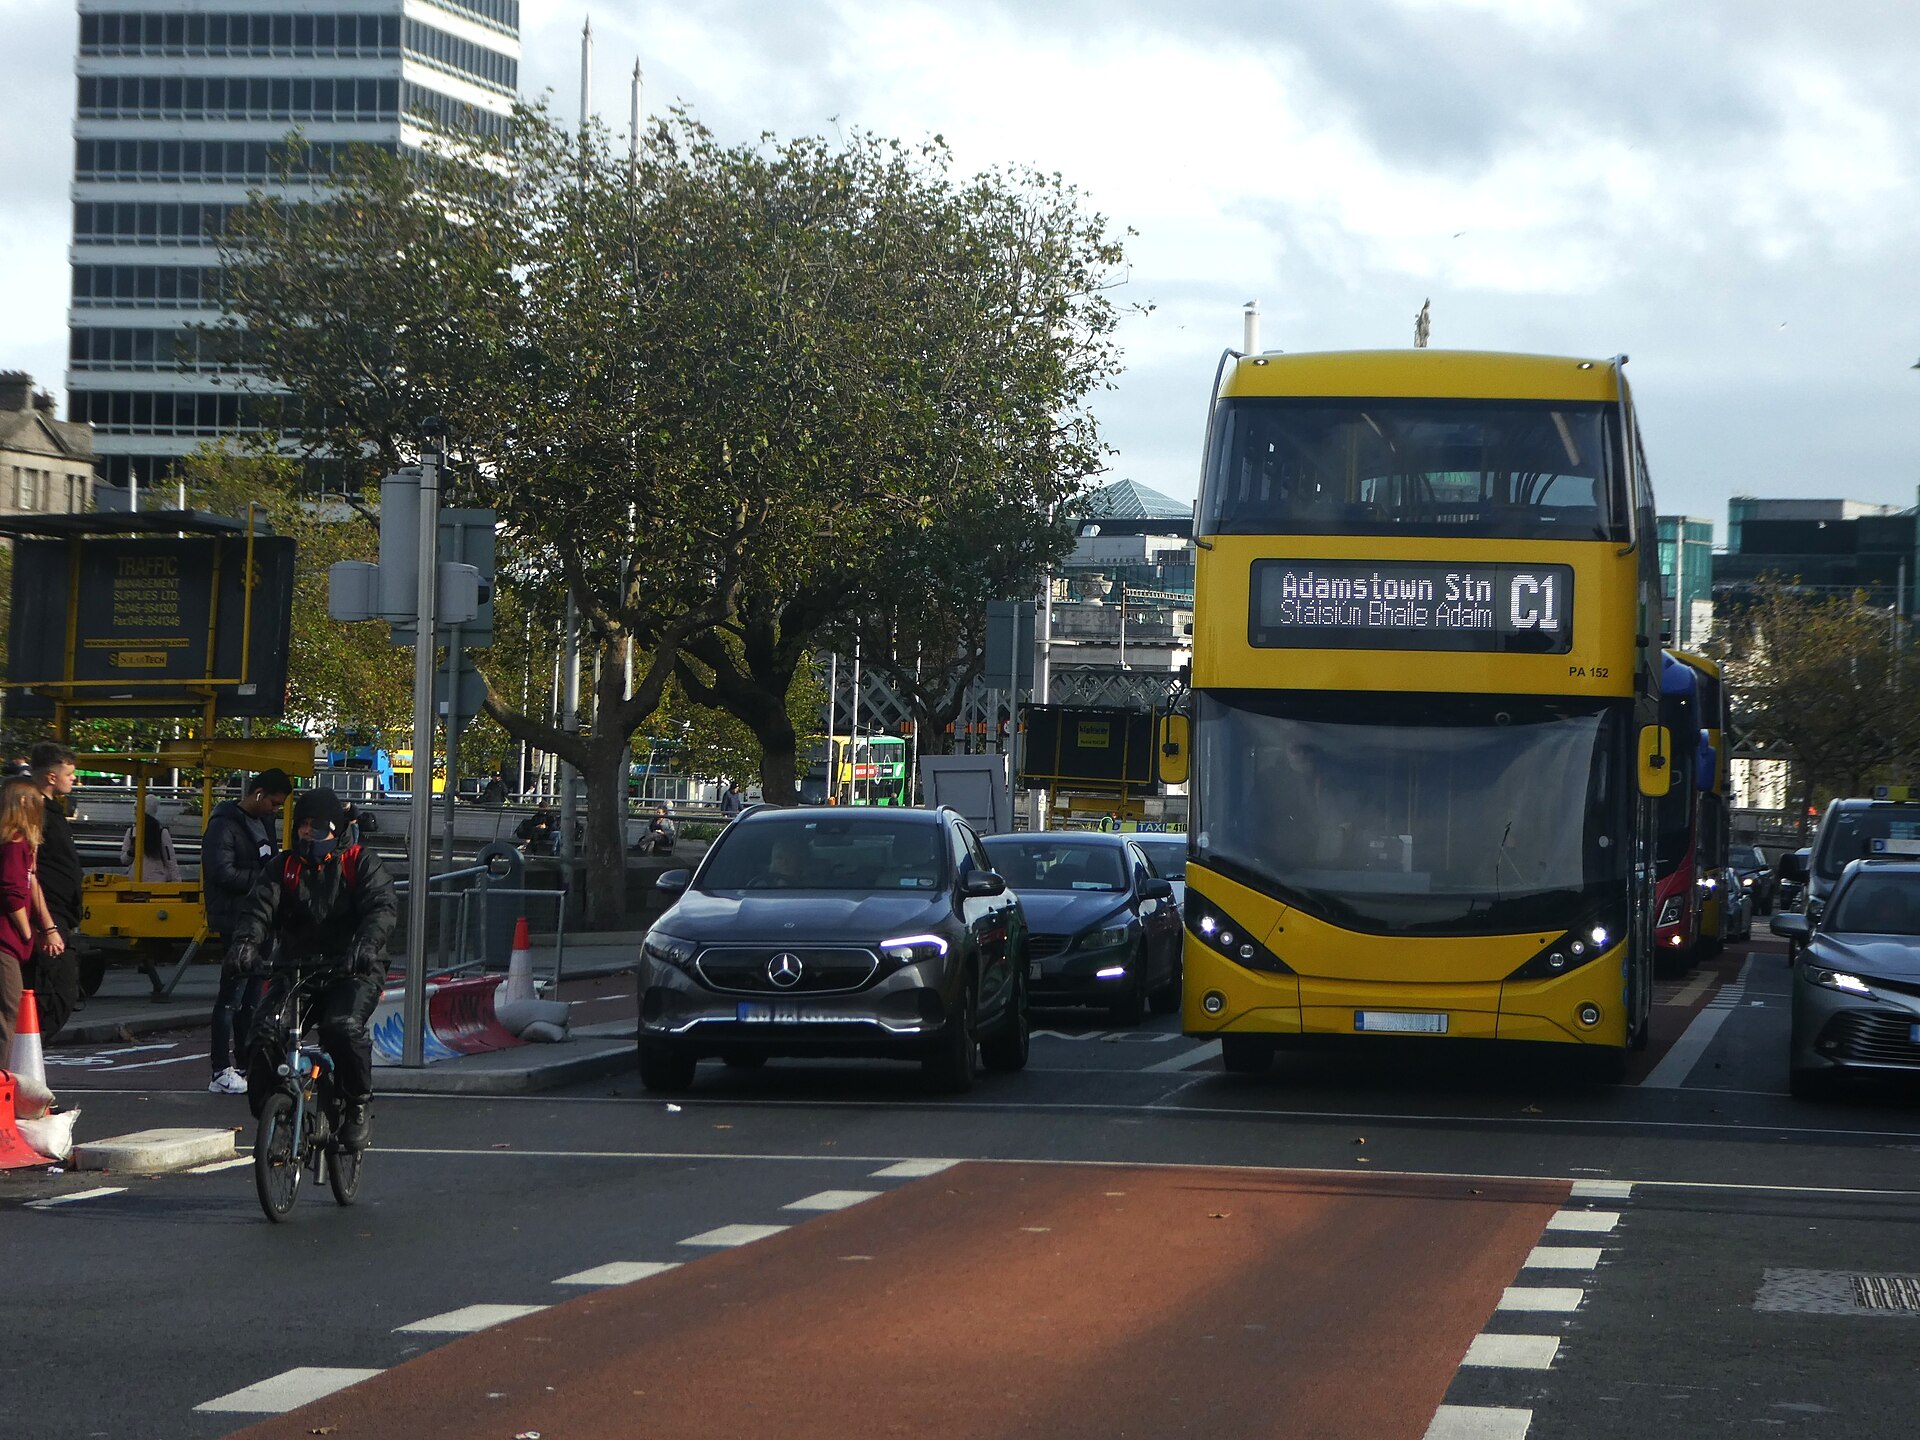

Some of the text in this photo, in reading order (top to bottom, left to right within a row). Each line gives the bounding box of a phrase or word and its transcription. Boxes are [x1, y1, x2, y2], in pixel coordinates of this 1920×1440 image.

[117, 556, 178, 576] TRAFFIC
[114, 578, 181, 588] MANAGEMENT
[1282, 571, 1491, 602] Adamstown Stn
[113, 591, 158, 601] SUPPLIES
[1509, 574, 1558, 629] C1
[1280, 599, 1493, 629] Stáisiún Bhaile Adaim
[1569, 666, 1609, 678] PA 152
[1111, 822, 1120, 831] D
[1138, 823, 1166, 832] TAXI
